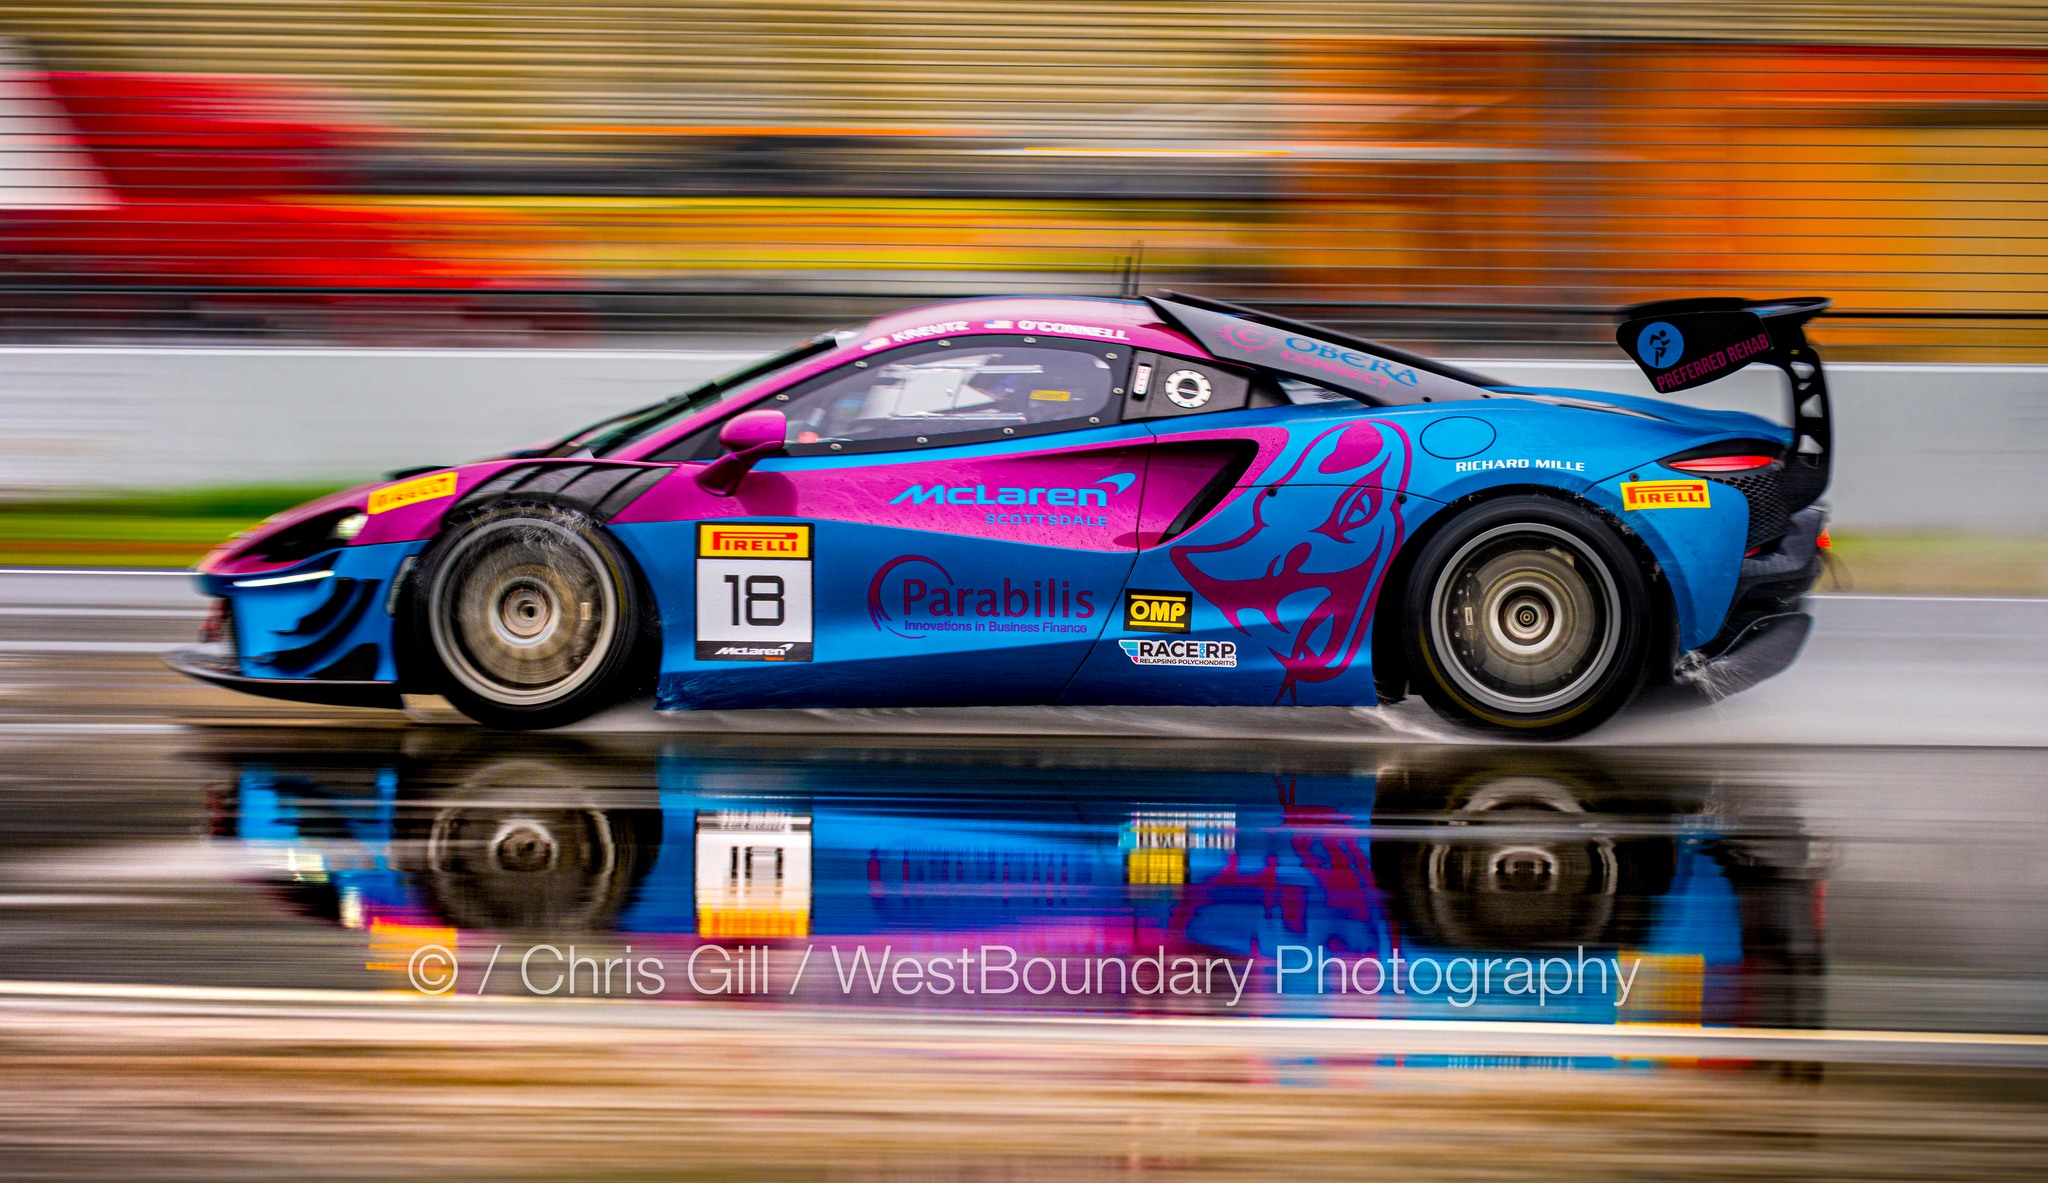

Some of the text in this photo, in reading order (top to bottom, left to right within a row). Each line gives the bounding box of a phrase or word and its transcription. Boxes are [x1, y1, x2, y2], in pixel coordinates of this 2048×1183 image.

[1017, 320, 1130, 340] O'CONNELL
[1726, 333, 1769, 363] REHAB
[1280, 351, 1393, 388] CONNECT
[1285, 337, 1418, 387] OBERA
[1656, 351, 1727, 392] PREFERRED
[1455, 458, 1585, 473] RICHARD MILLE
[888, 484, 1108, 507] McLaren
[1626, 484, 1705, 504] PIRELLI
[985, 513, 1108, 527] SCOTTSDALE
[712, 531, 798, 552] PIRELLI
[724, 574, 785, 626] 18
[903, 577, 1095, 619] Parabilis
[1130, 600, 1186, 622] OMP
[904, 620, 1087, 633] Innovations in Business Finance
[715, 647, 786, 656] McLaren
[1140, 642, 1199, 658] RACE
[1206, 643, 1235, 659] RP
[1178, 659, 1236, 667] POLYCHONDRITIS
